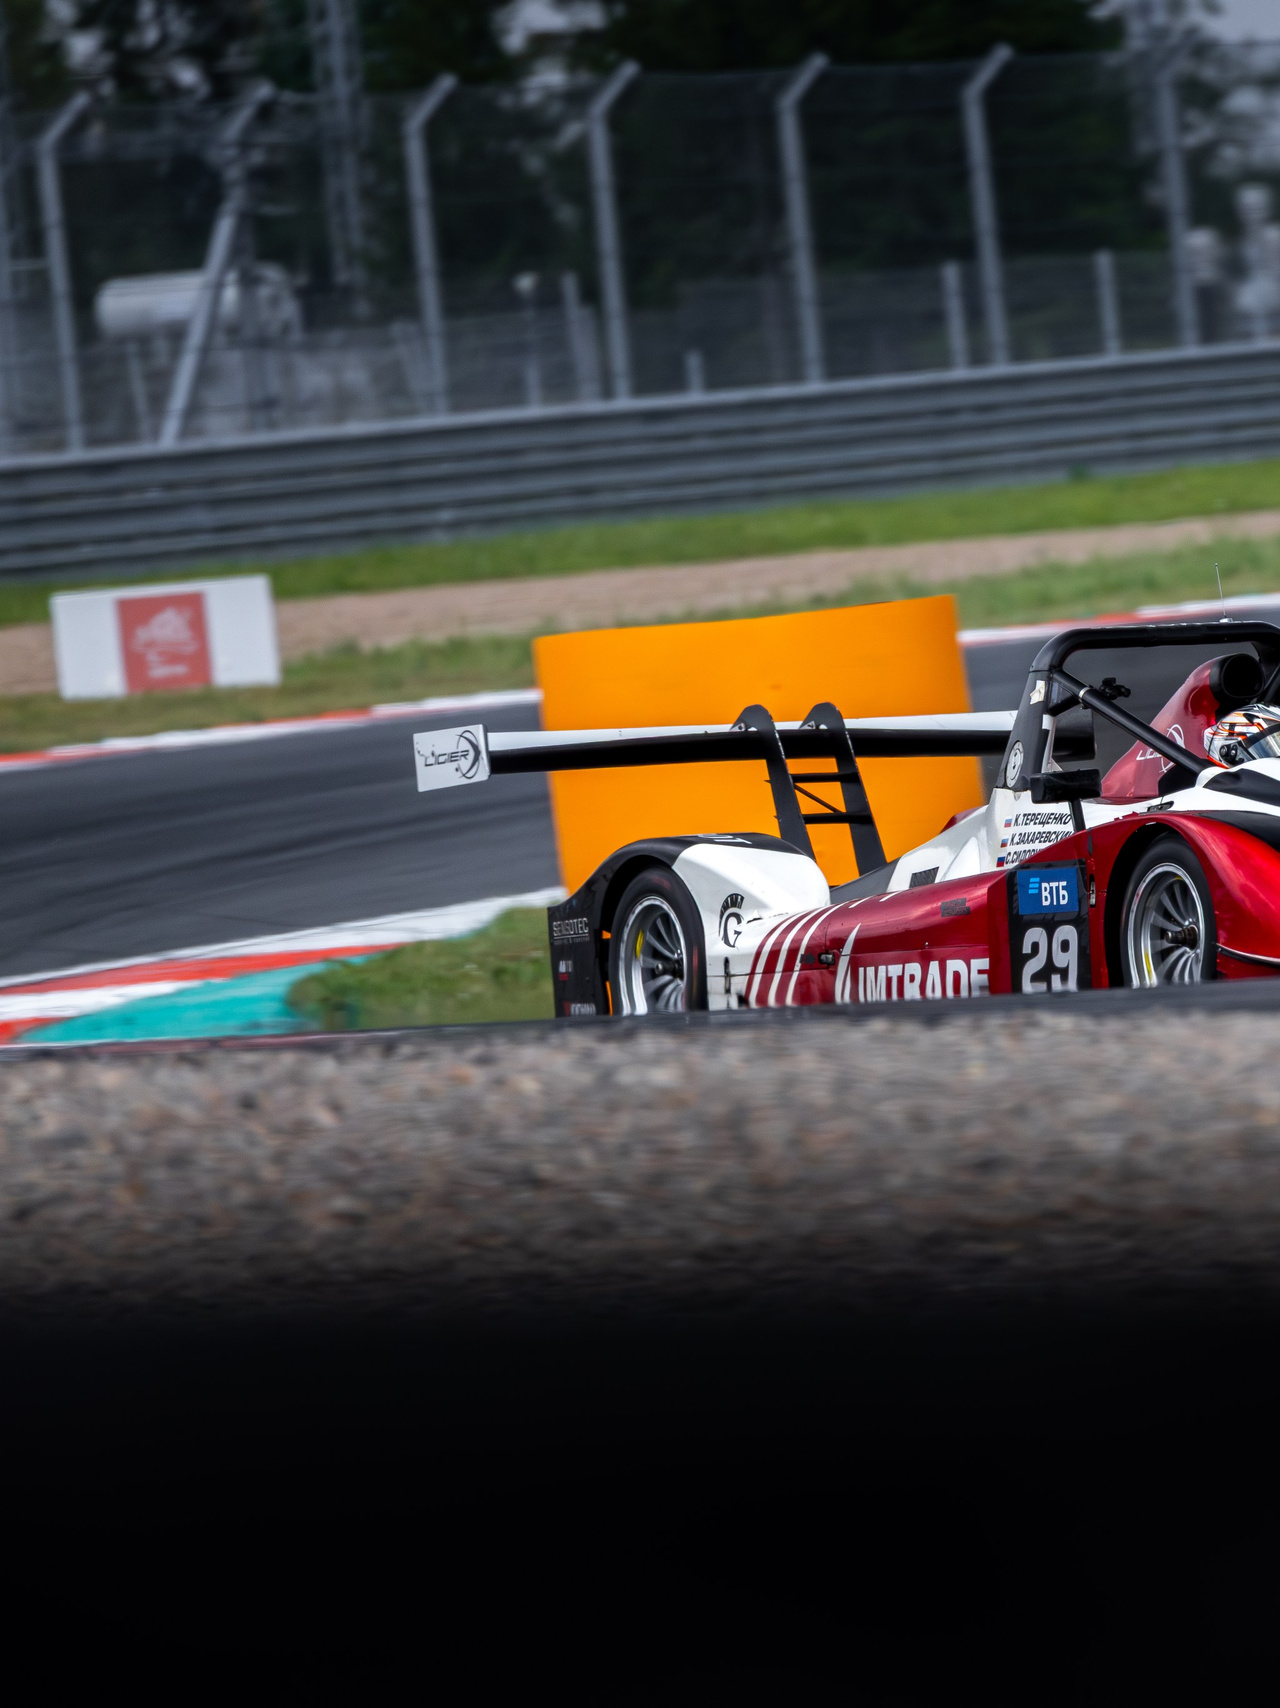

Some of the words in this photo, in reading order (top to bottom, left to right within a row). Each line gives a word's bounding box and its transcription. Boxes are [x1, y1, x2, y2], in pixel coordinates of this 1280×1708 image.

[424, 749, 470, 767] LIGIER
[1041, 881, 1069, 907] ВТБ
[1021, 924, 1079, 994] 29
